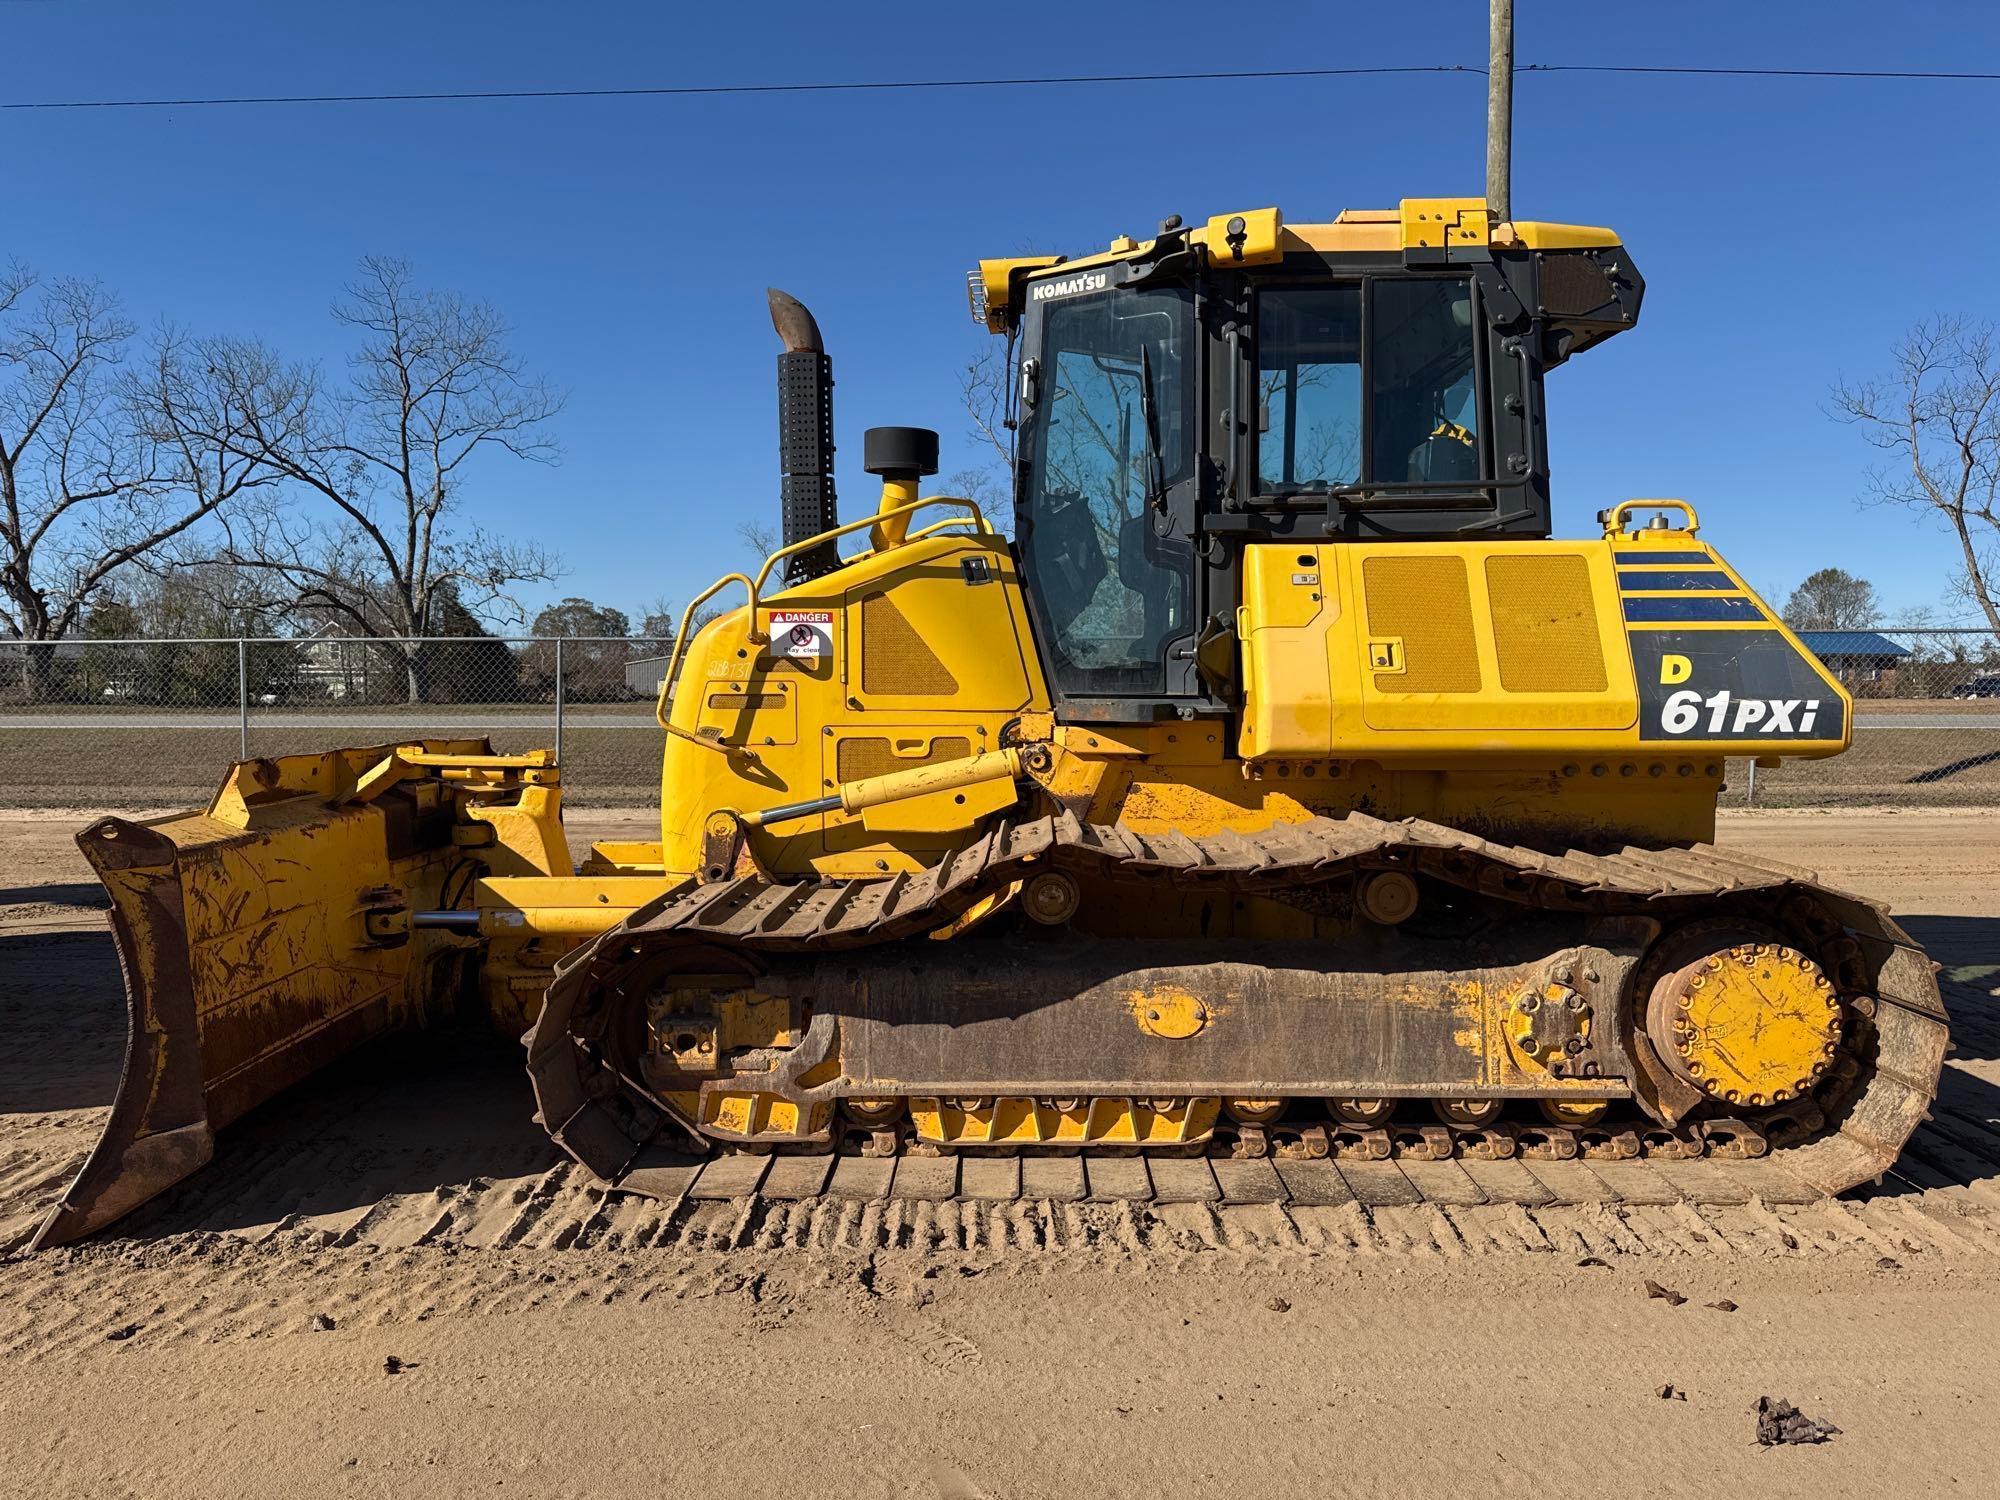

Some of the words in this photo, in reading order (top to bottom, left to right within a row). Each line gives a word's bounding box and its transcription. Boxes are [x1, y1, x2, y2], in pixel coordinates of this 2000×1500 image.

[1033, 273, 1106, 300] KOMATSU
[785, 613, 829, 622] DANGER
[1660, 654, 1693, 685] D
[1661, 690, 1820, 734] 61PXi
